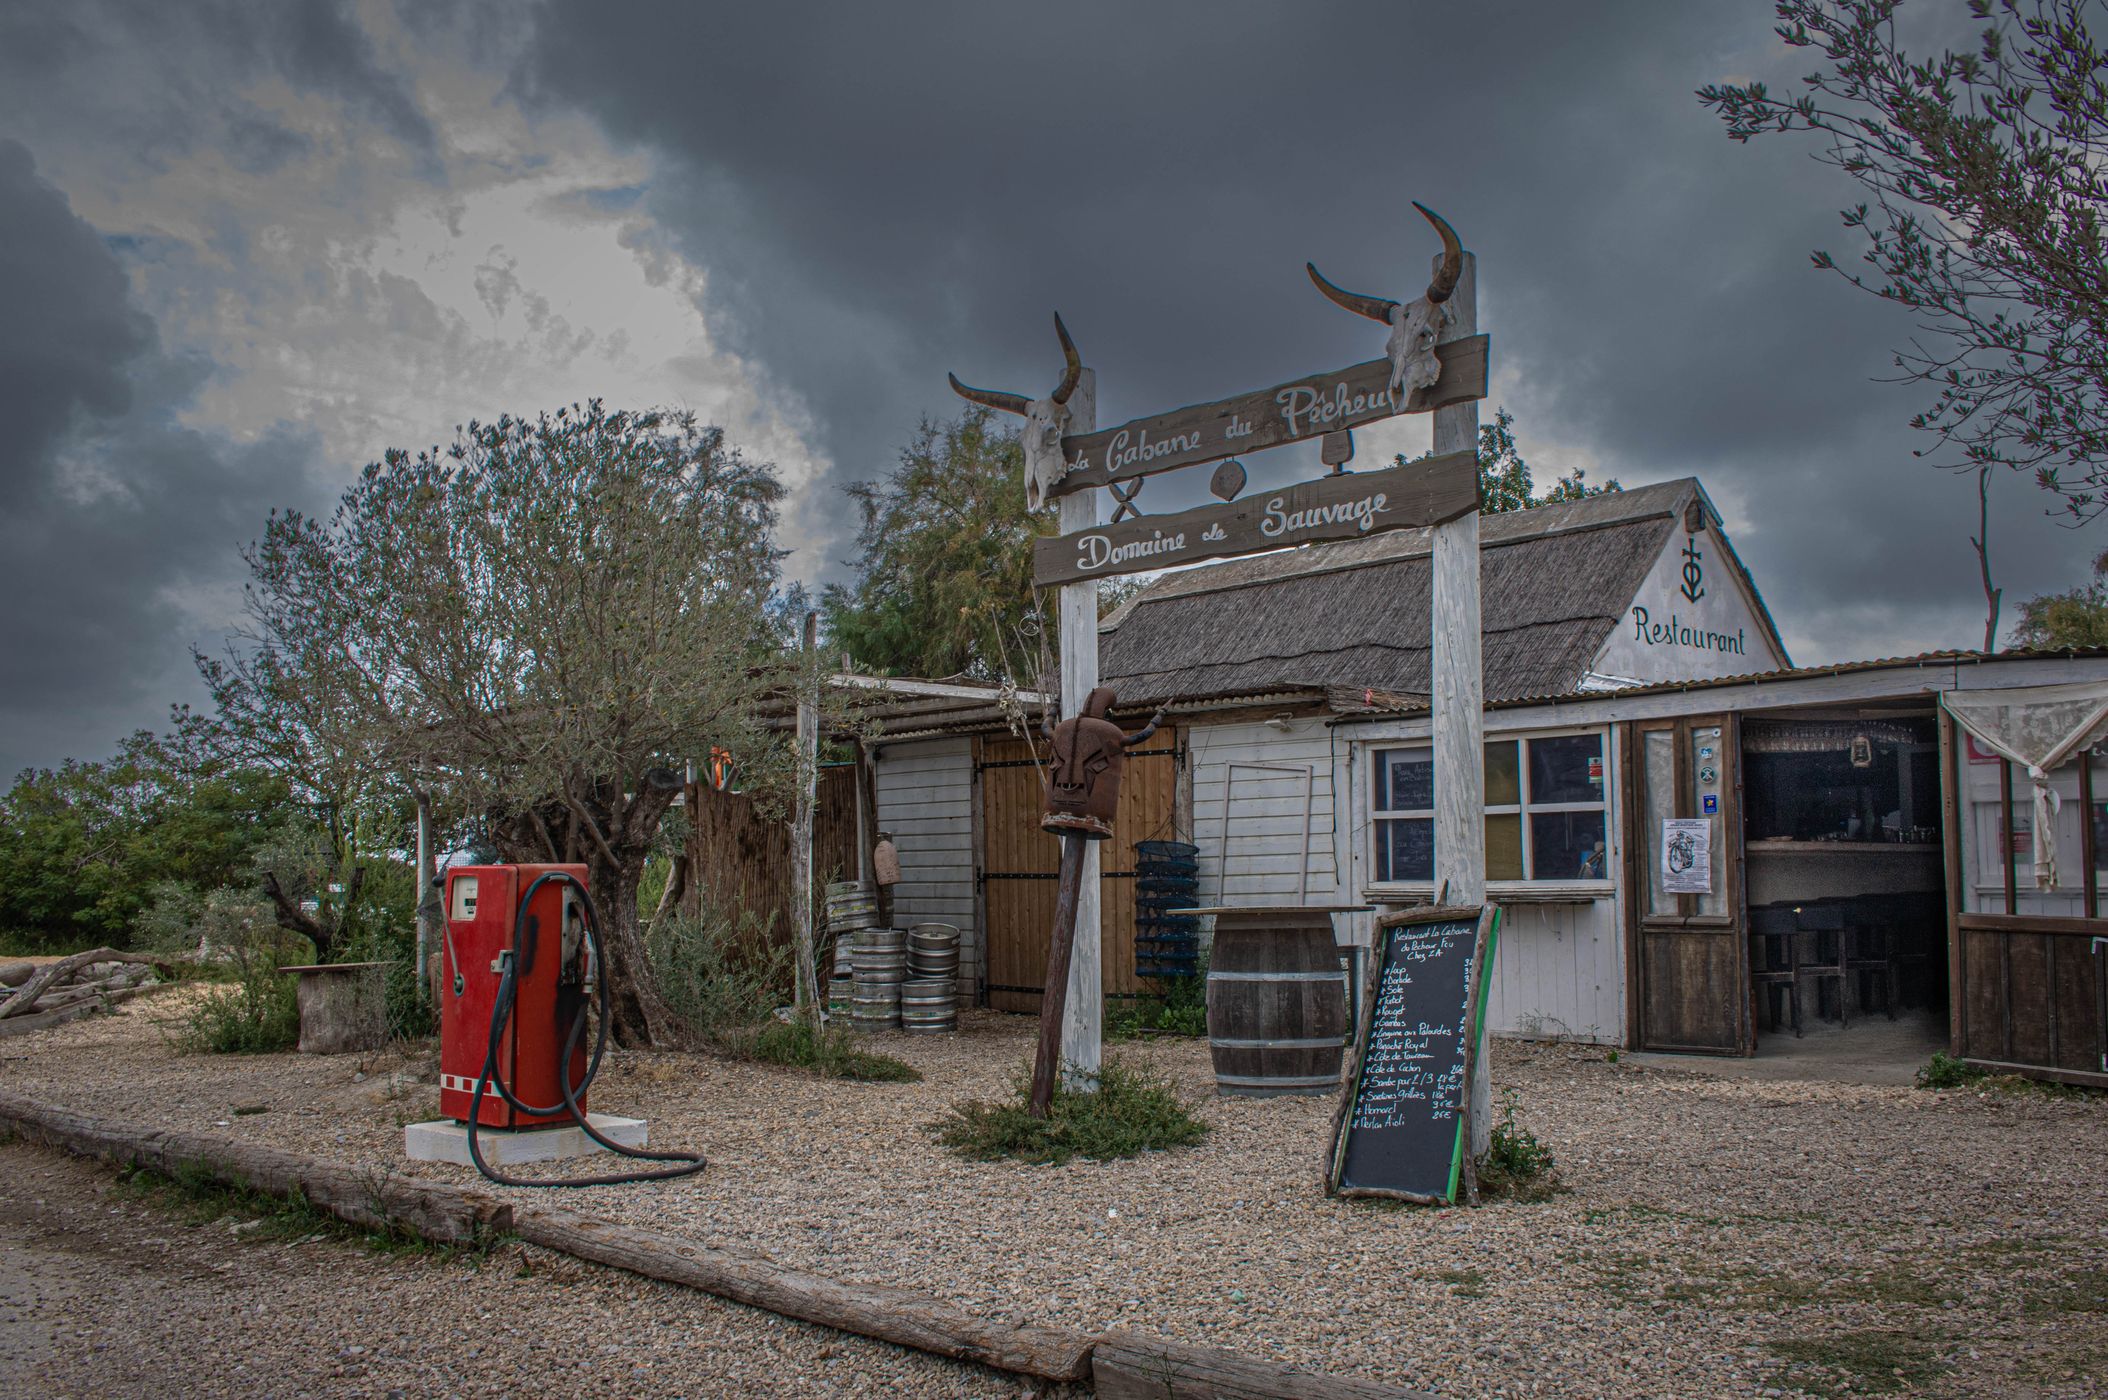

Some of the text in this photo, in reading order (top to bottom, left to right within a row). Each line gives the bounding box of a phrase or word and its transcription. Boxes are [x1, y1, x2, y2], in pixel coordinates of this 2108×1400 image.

[1068, 382, 1387, 472] La Cabane du Pêcheu
[1077, 530, 1185, 569] Domaine
[1261, 493, 1392, 537] Sauvage
[1632, 606, 1746, 656] Restaurant
[1394, 926, 1431, 942] Restaurant
[1441, 924, 1472, 936] Cabane
[1441, 937, 1454, 948] Fou
[1407, 950, 1427, 962] Chez
[1387, 985, 1404, 995] Sole
[1384, 995, 1405, 1005] Turbot
[1379, 1017, 1407, 1027] Gambas
[1419, 1022, 1452, 1036] Palourdes
[1404, 1037, 1429, 1052] Royal
[1391, 1052, 1402, 1061] de
[1364, 1102, 1397, 1115] Homard
